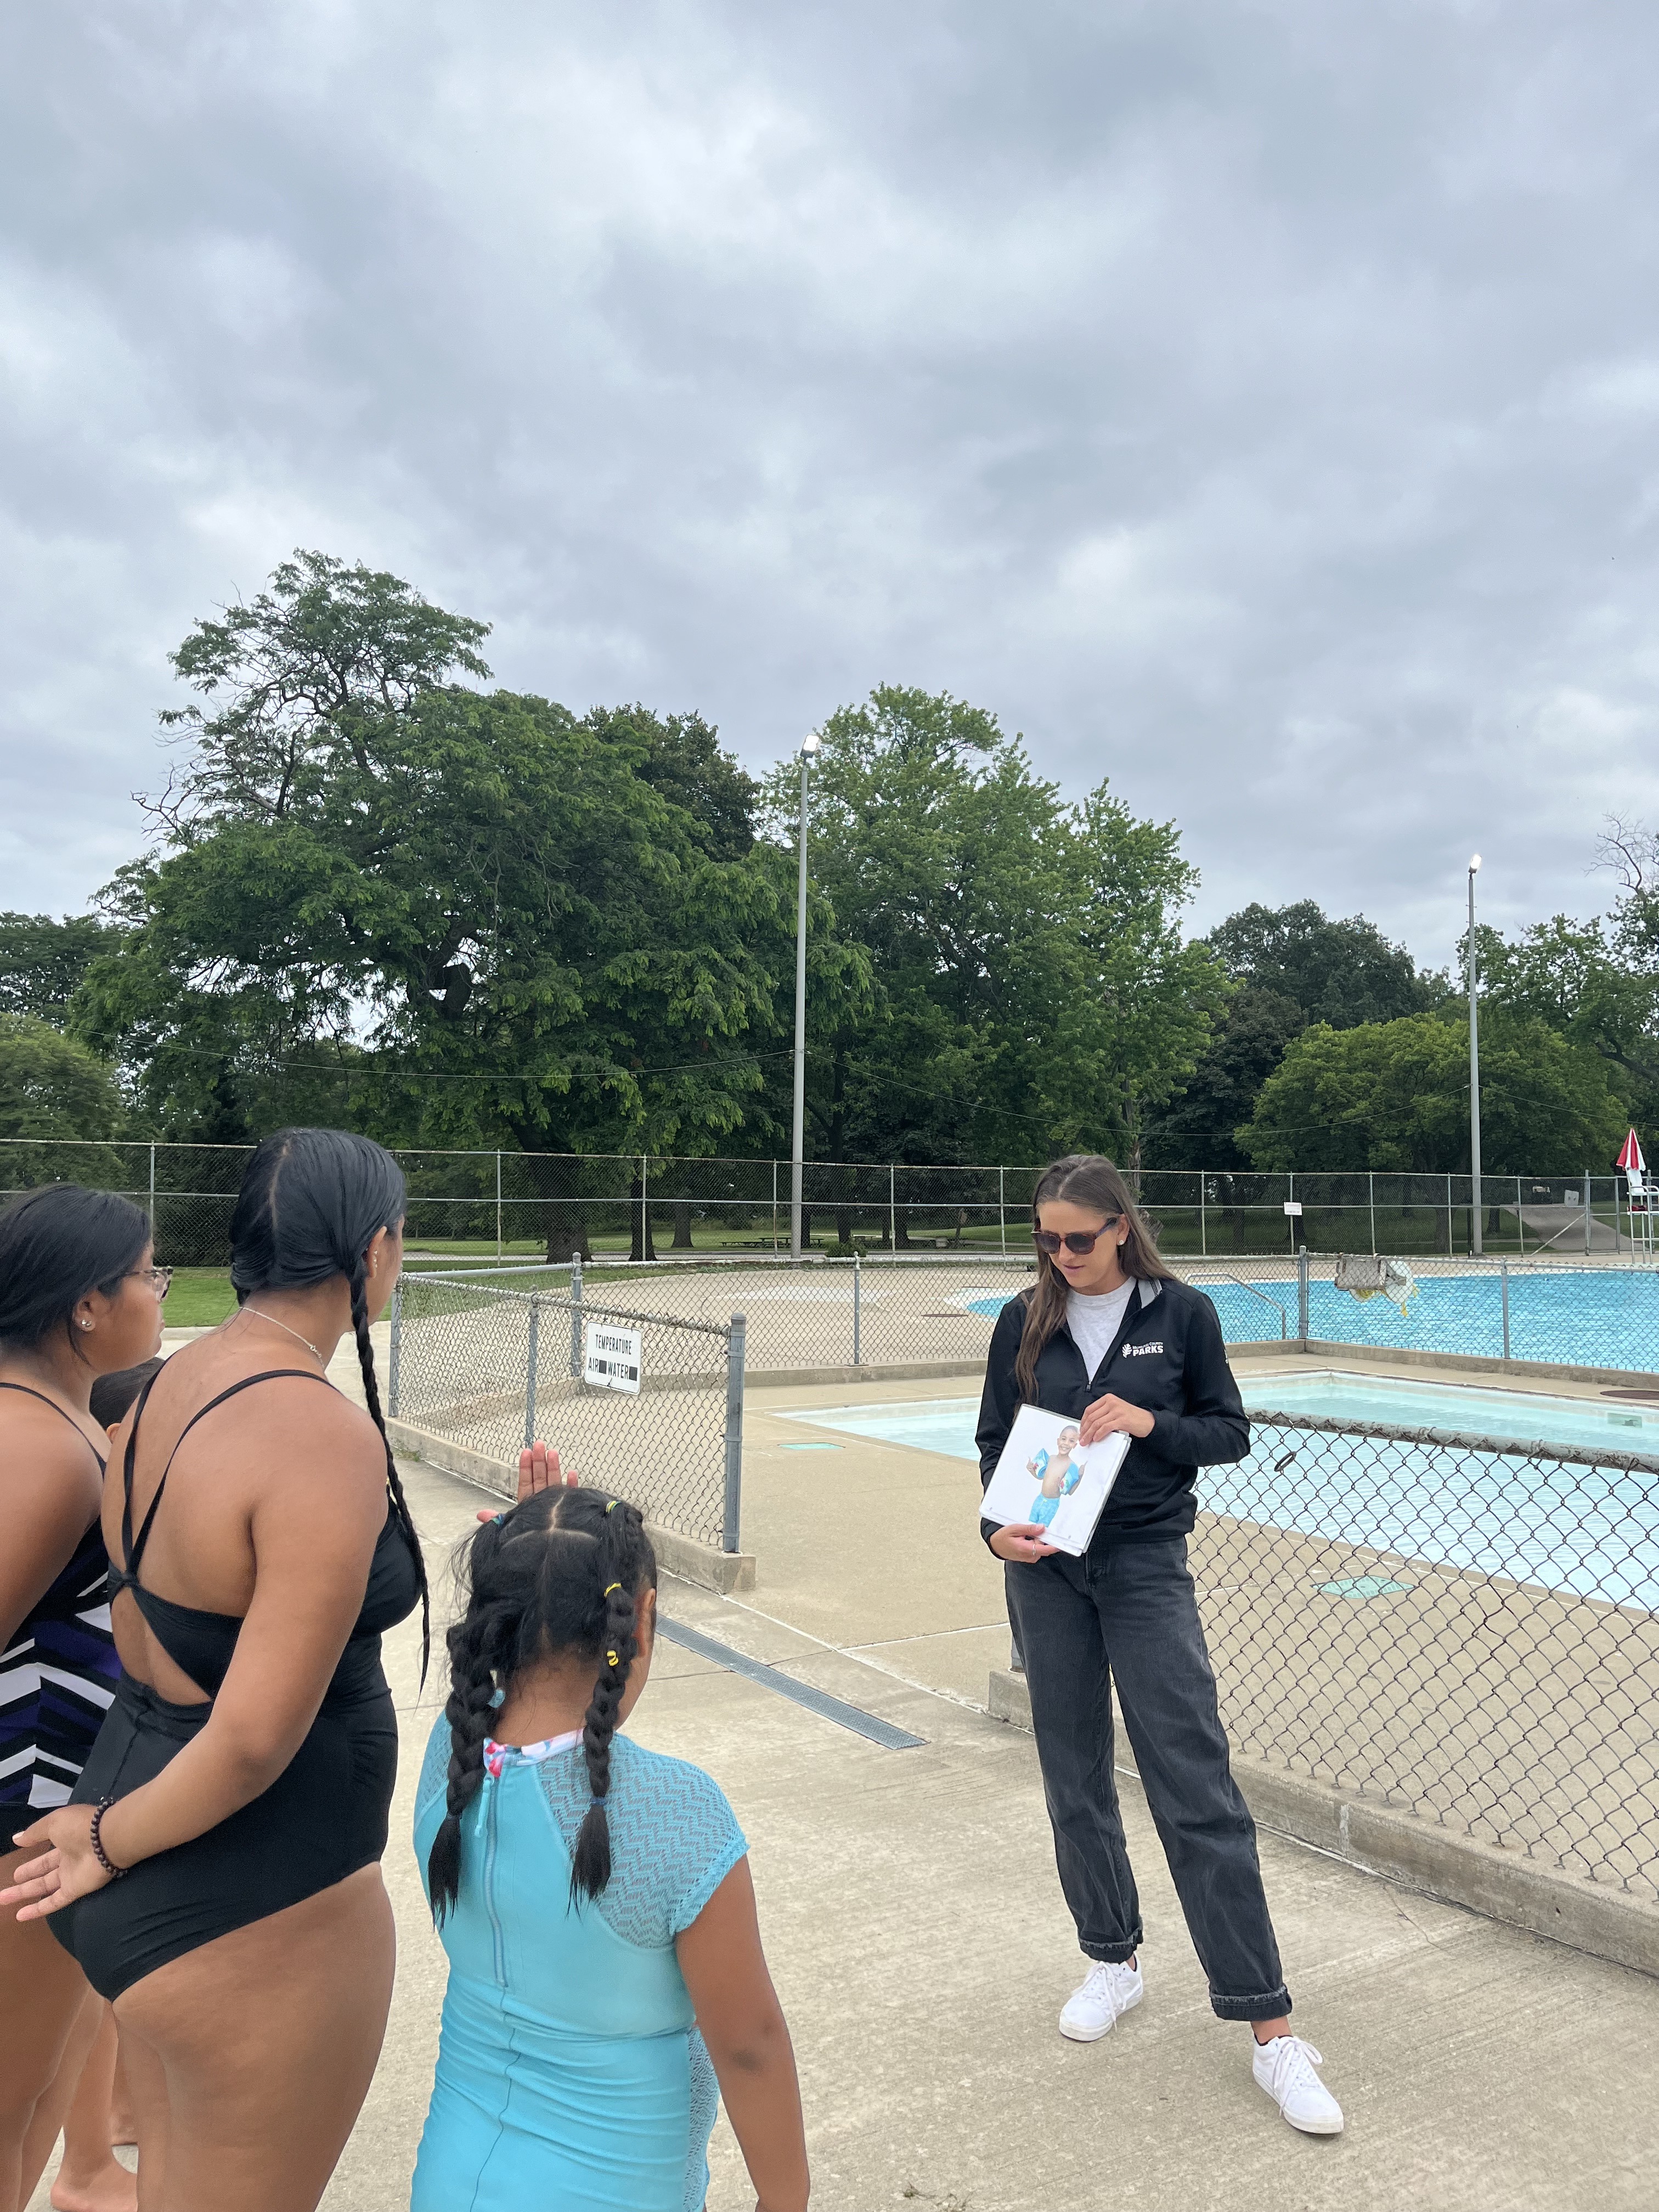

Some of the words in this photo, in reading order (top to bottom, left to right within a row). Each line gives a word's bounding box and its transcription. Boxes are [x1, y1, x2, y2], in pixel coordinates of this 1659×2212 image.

[596, 1334, 631, 1355] TEMPERATURE
[1133, 1345, 1163, 1356] PARKS
[588, 1357, 599, 1373] AIR
[608, 1361, 629, 1379] WATER
